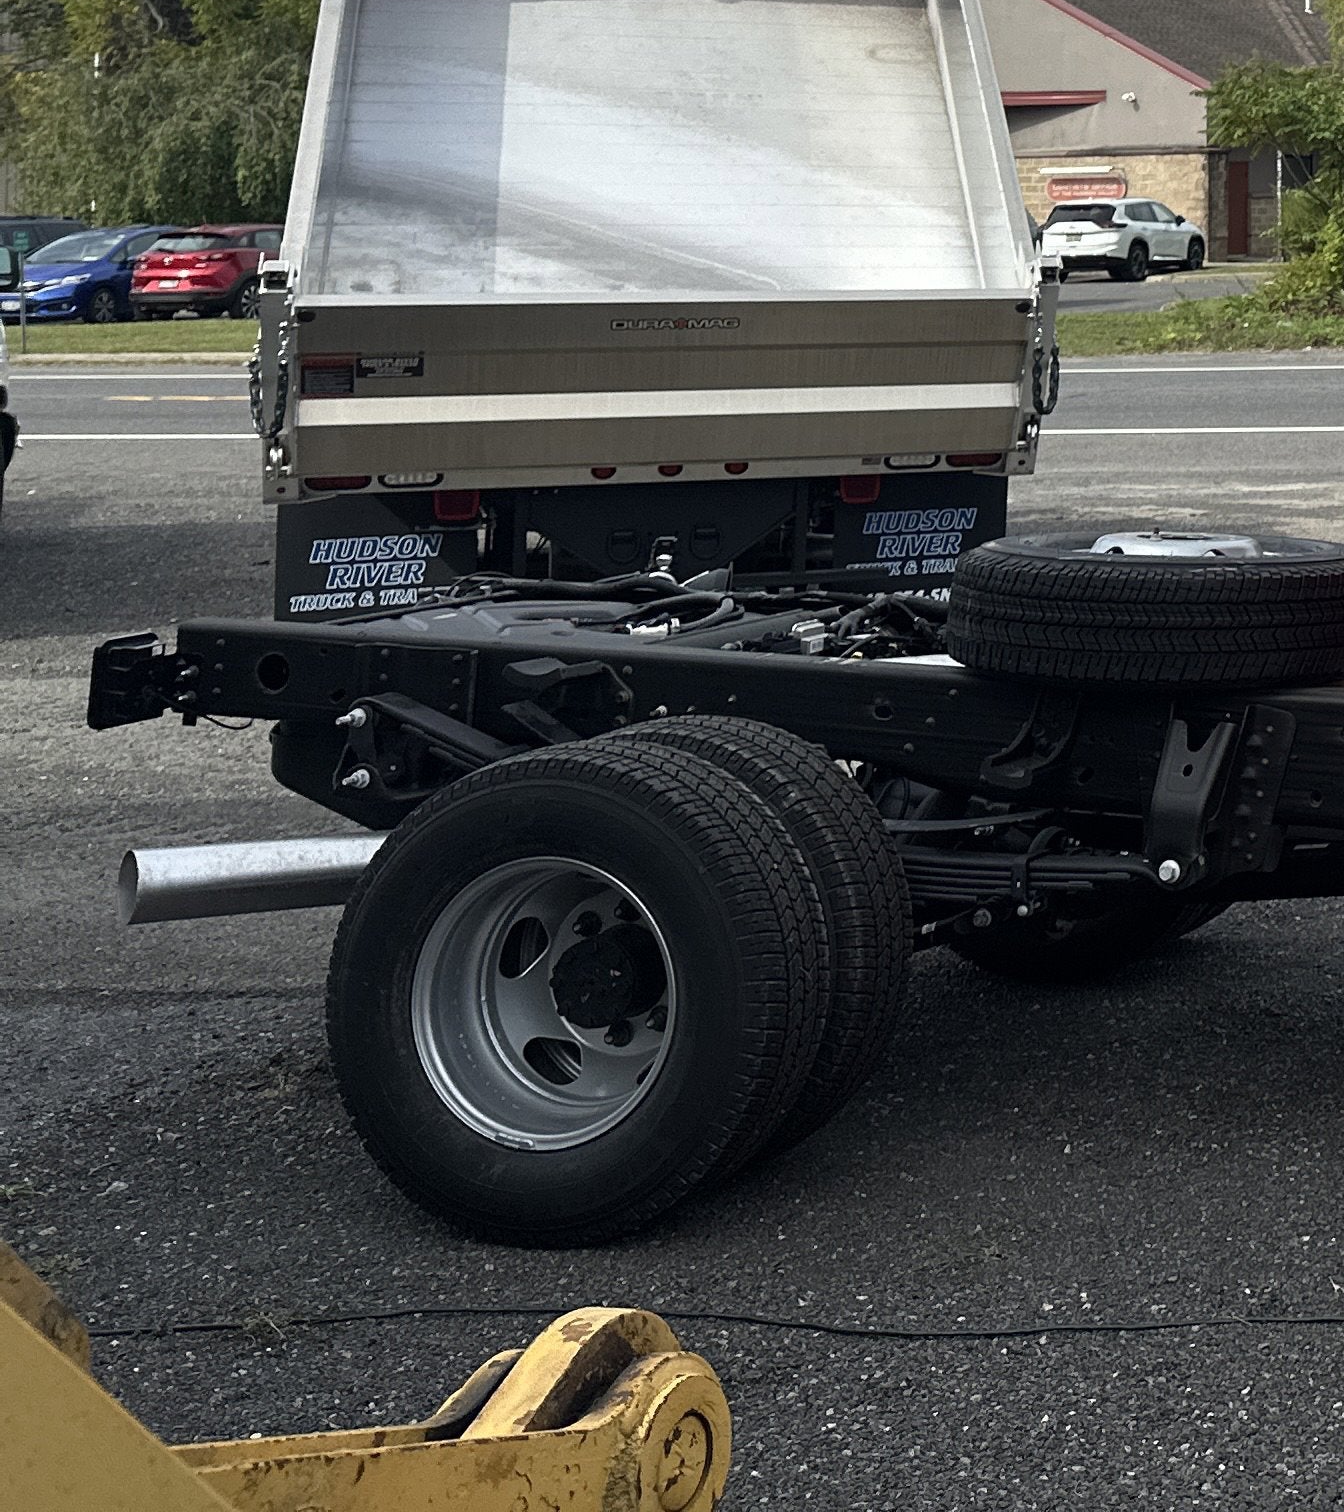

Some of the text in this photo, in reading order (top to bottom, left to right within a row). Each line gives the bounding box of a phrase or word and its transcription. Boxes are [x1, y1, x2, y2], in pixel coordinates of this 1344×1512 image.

[862, 507, 978, 535] HUDSON
[309, 533, 444, 564] HUDSON
[876, 531, 963, 559] RIVER
[326, 560, 426, 590] RIVER
[904, 558, 918, 576] &
[922, 557, 959, 575] TRA
[289, 587, 418, 613] TRUCK & TRA
